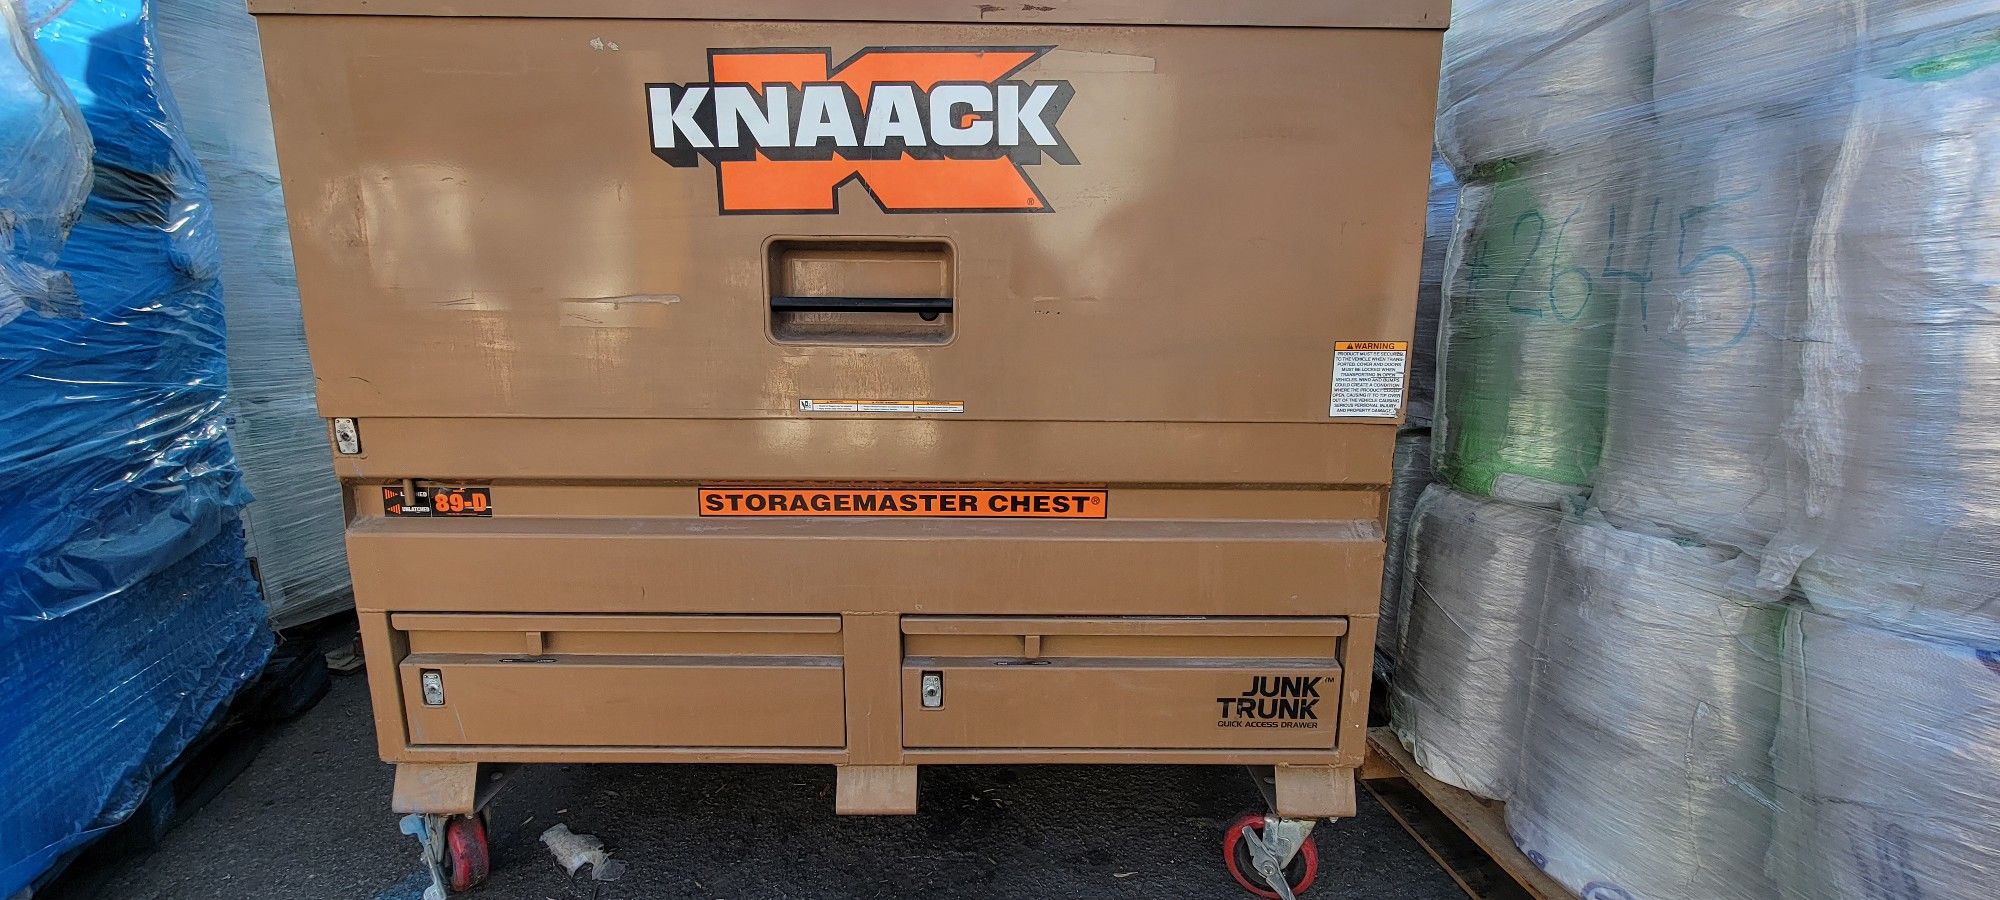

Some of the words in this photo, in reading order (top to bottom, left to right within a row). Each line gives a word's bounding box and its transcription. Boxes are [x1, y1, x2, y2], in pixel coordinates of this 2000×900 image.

[645, 80, 1080, 167] KNAACK
[1354, 342, 1395, 350] WARNING
[435, 493, 487, 512] 89-D
[705, 493, 978, 512] STORAGEMASTER
[1216, 697, 1320, 720] TRUNK
[1217, 720, 1243, 728] QUICK
[1280, 721, 1318, 729] DRAWER
